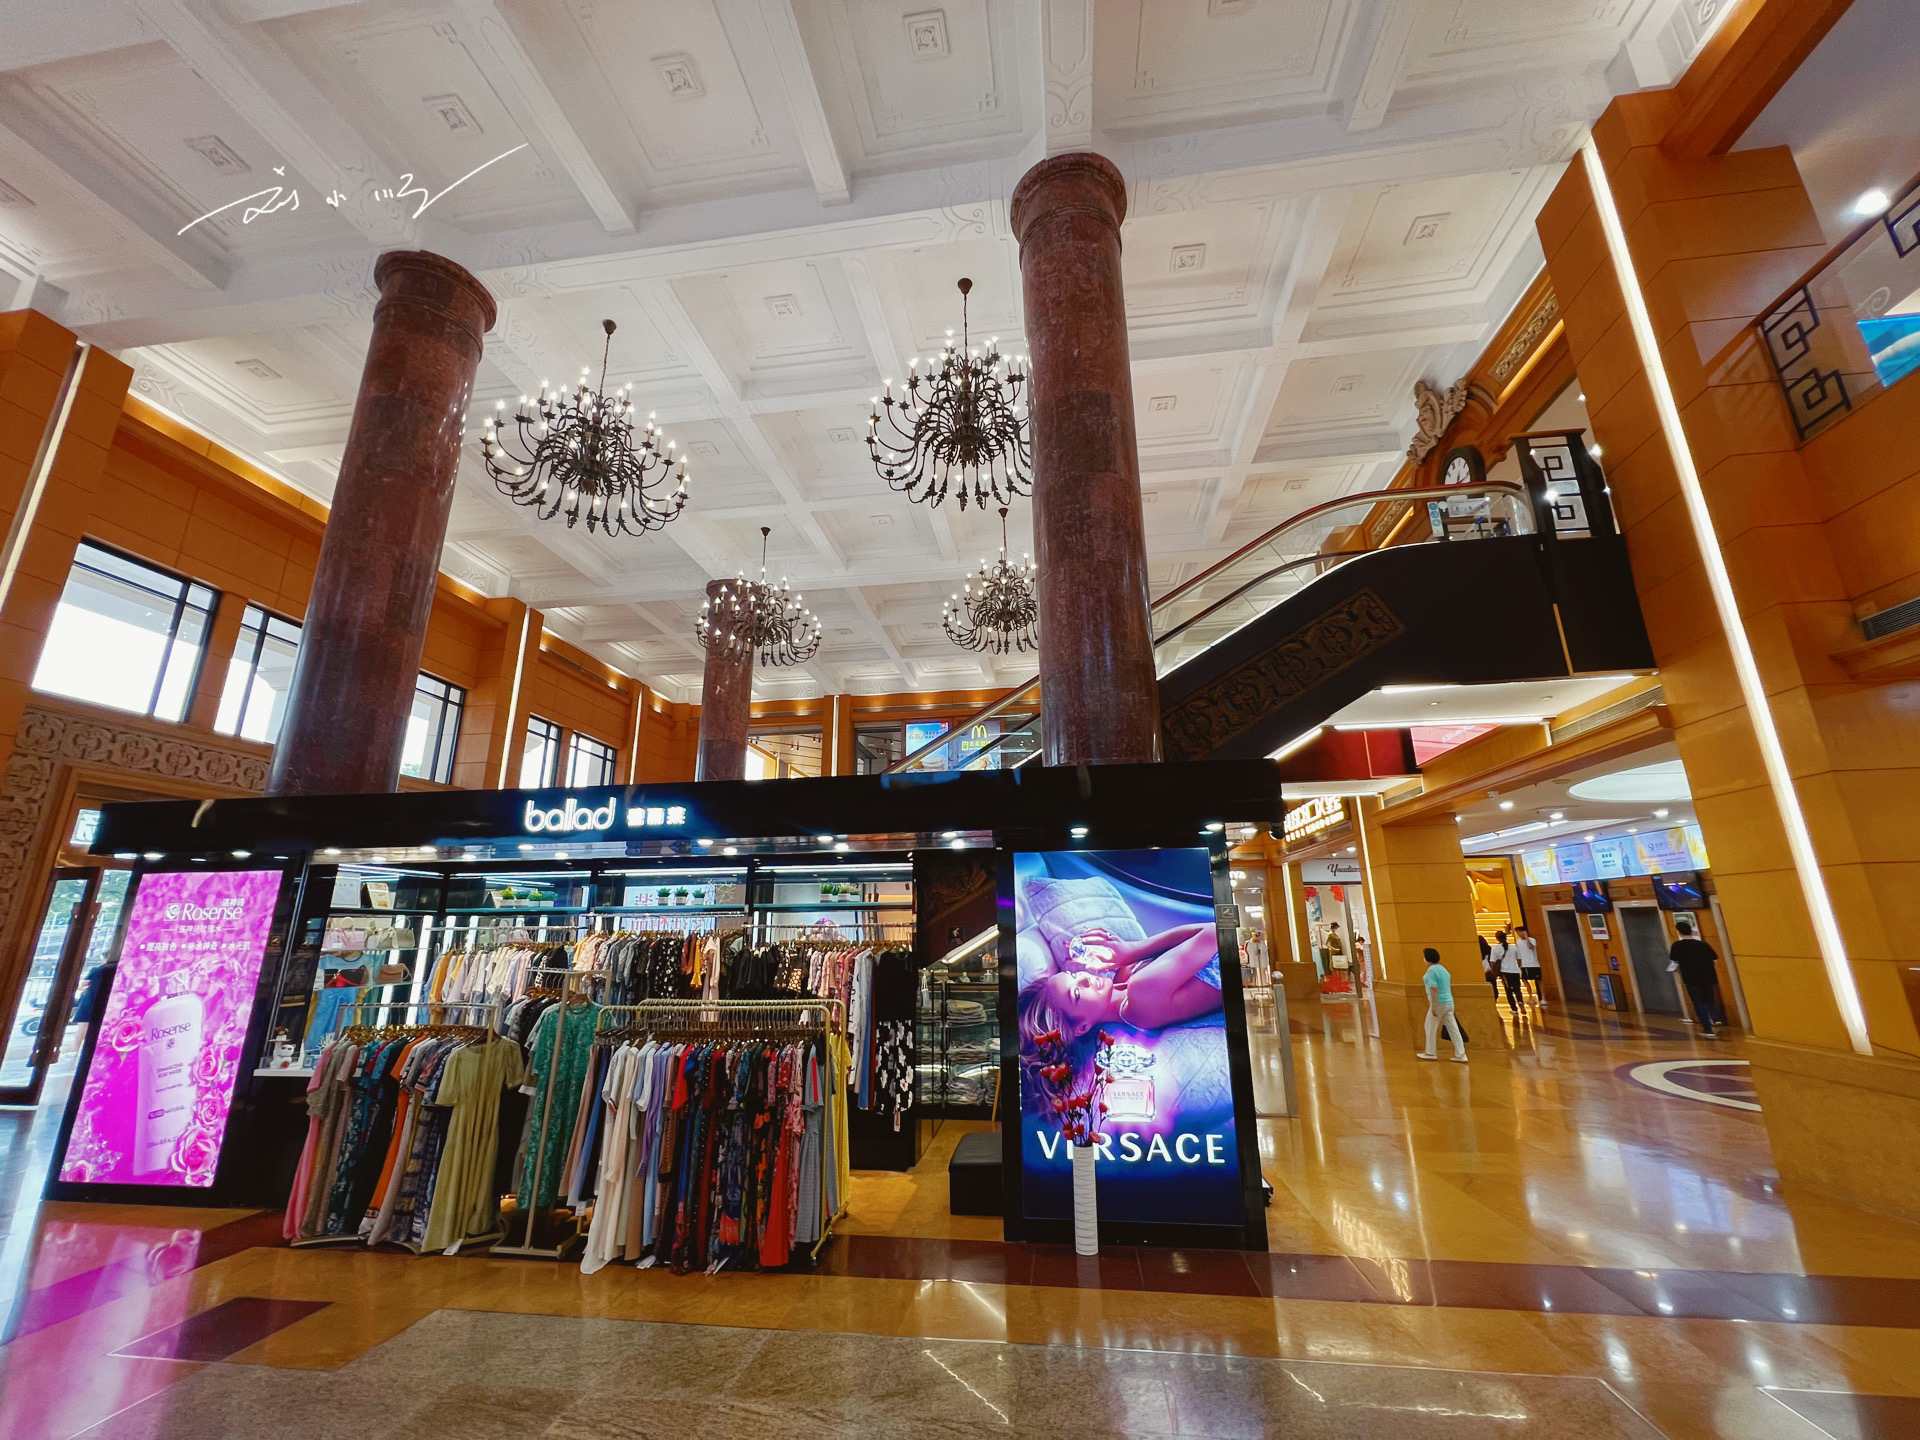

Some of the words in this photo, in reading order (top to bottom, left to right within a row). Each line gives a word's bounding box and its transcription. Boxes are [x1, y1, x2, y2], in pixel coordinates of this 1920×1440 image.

[524, 797, 617, 832] ballad
[182, 903, 243, 921] Rosense
[151, 1021, 192, 1042] Rosense
